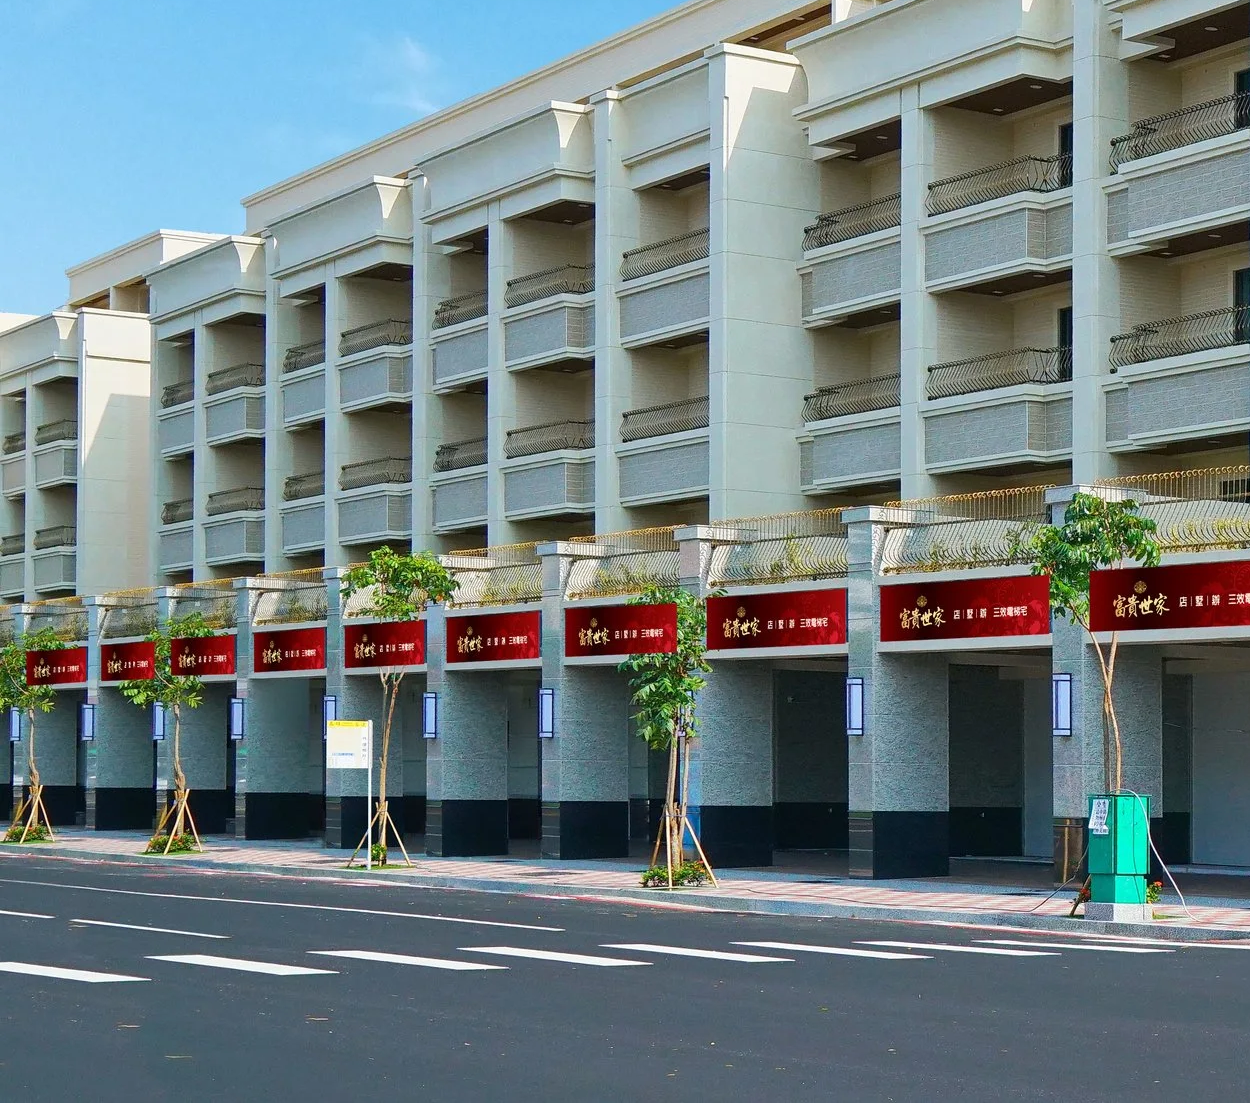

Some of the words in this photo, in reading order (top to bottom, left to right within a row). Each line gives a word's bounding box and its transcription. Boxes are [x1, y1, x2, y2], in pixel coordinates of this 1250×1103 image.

[1112, 592, 1171, 618] 富貴世家
[899, 606, 947, 630] 富貴世家
